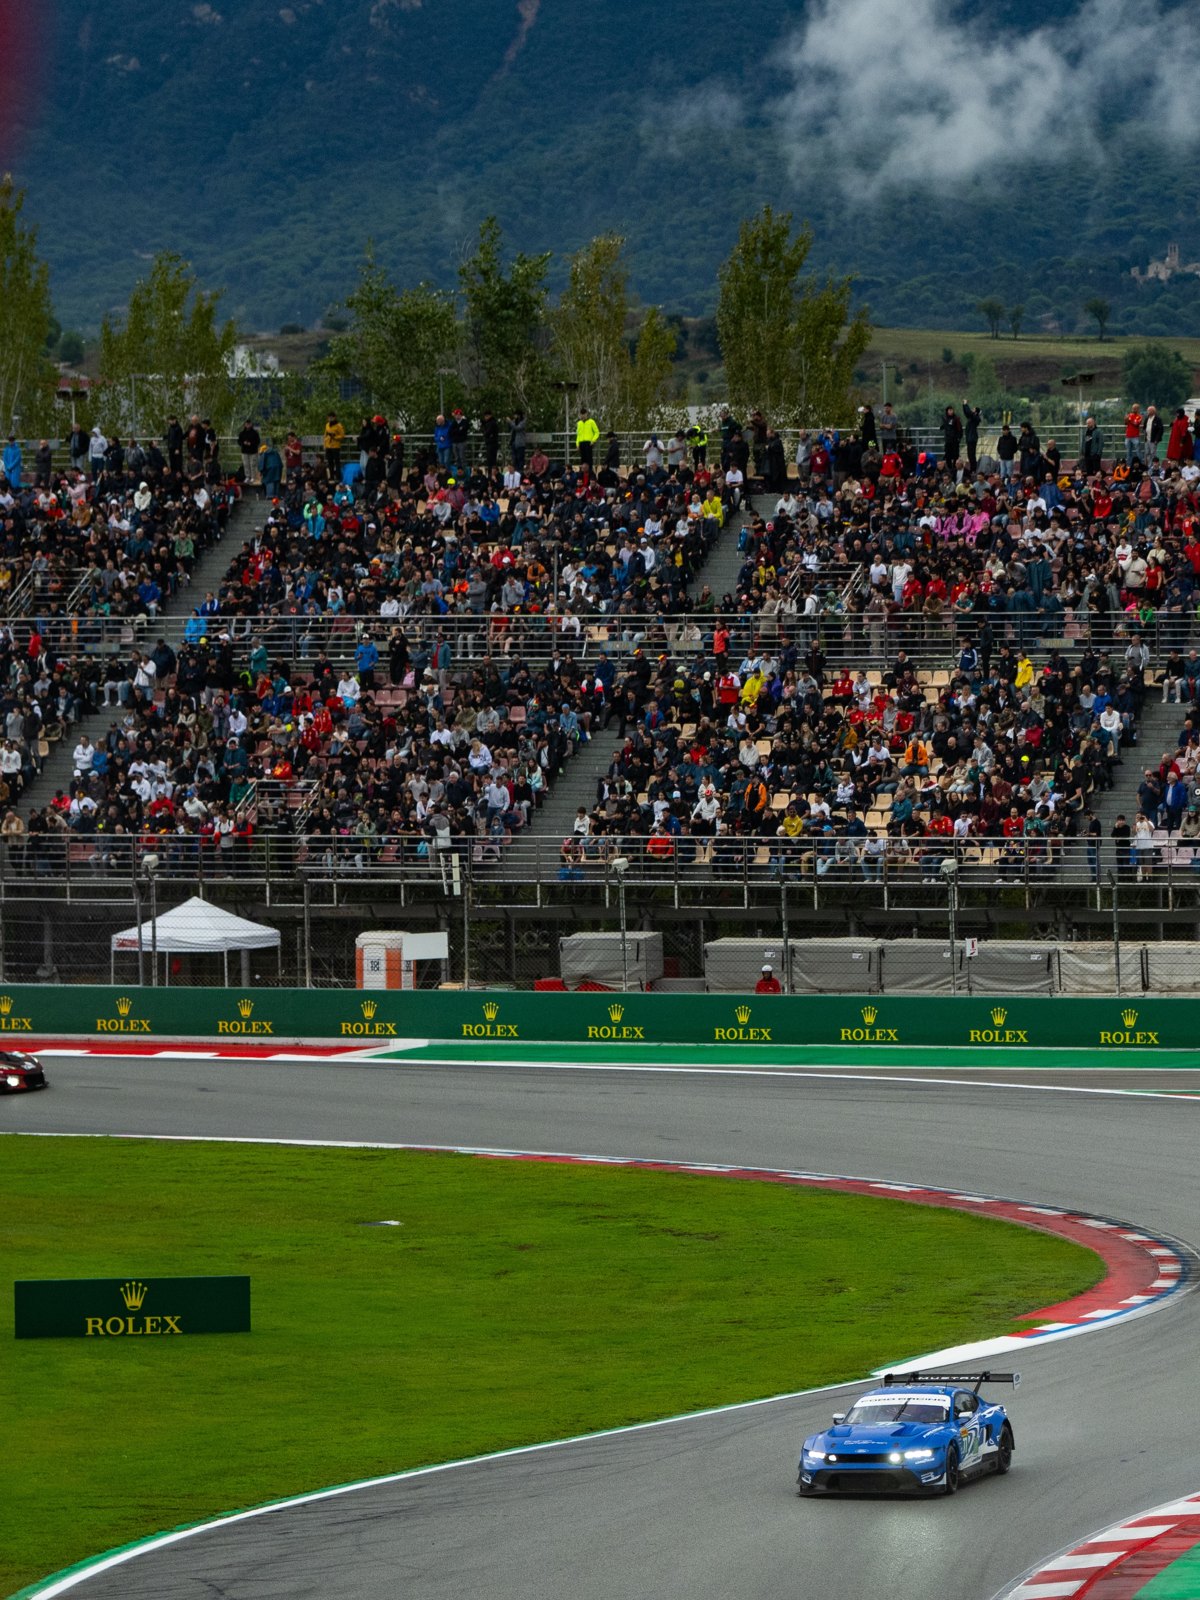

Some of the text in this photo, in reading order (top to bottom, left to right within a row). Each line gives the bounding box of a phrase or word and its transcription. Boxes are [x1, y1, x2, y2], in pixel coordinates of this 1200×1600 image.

[0, 1017, 32, 1030] LEX
[96, 1018, 151, 1032] ROLEX
[217, 1020, 273, 1034] ROLEX
[341, 1022, 397, 1035] ROLEX
[462, 1023, 518, 1037] ROLEX
[588, 1026, 644, 1039] ROLEX
[715, 1027, 772, 1041] ROLEX
[841, 1028, 898, 1041] ROLEX
[970, 1029, 1028, 1043] ROLEX
[1100, 1031, 1159, 1044] ROLEX
[85, 1315, 183, 1336] ROLEX
